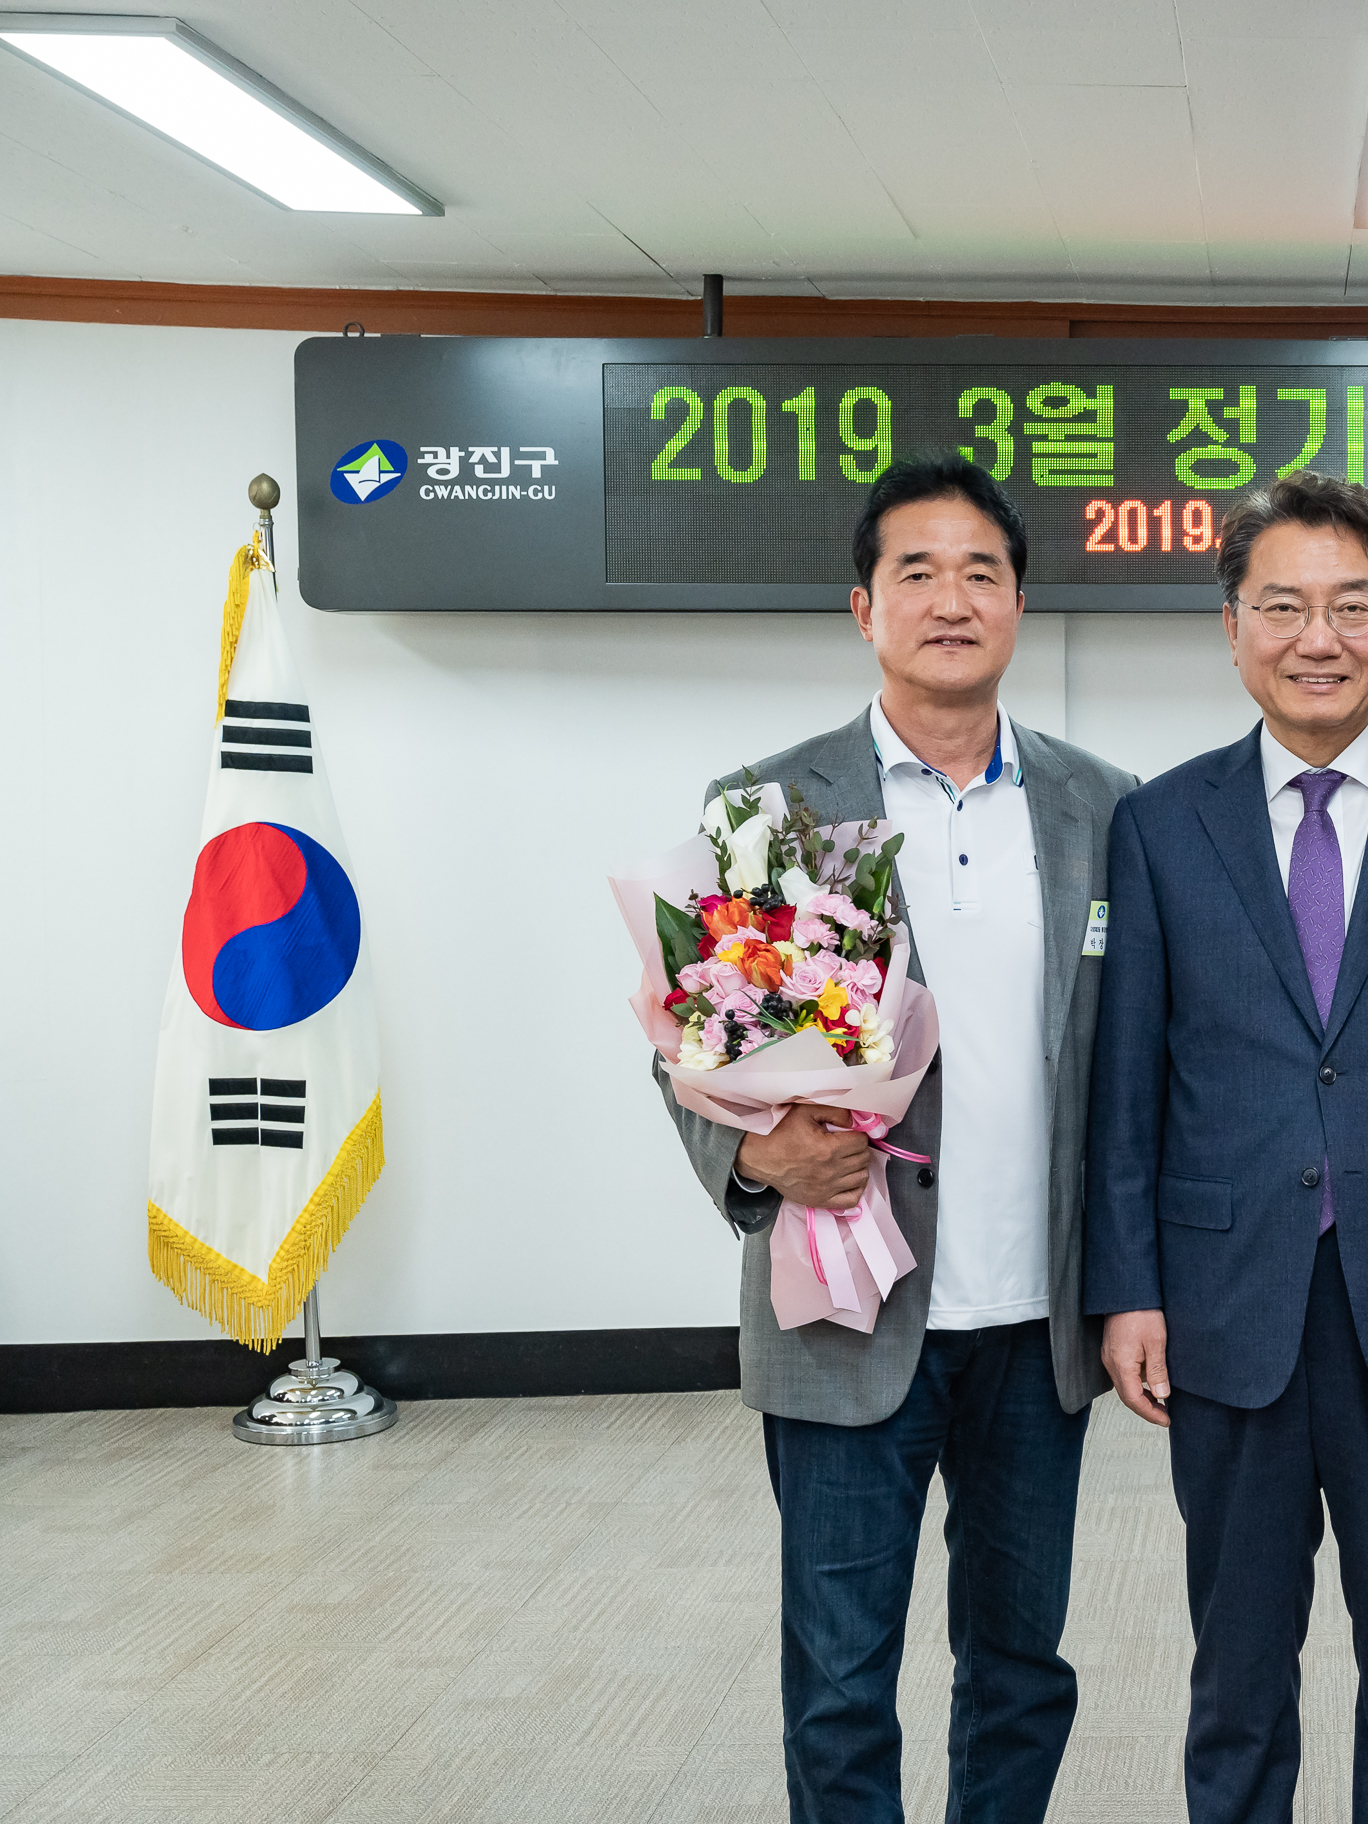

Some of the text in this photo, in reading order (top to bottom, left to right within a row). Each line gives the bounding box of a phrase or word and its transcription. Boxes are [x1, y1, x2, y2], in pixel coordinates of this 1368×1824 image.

[650, 385, 892, 483] 2019
[957, 381, 1115, 486] 3월
[1165, 385, 1365, 490] 정기
[416, 446, 560, 481] 광진구
[418, 484, 557, 500] GWANGJIN-GU
